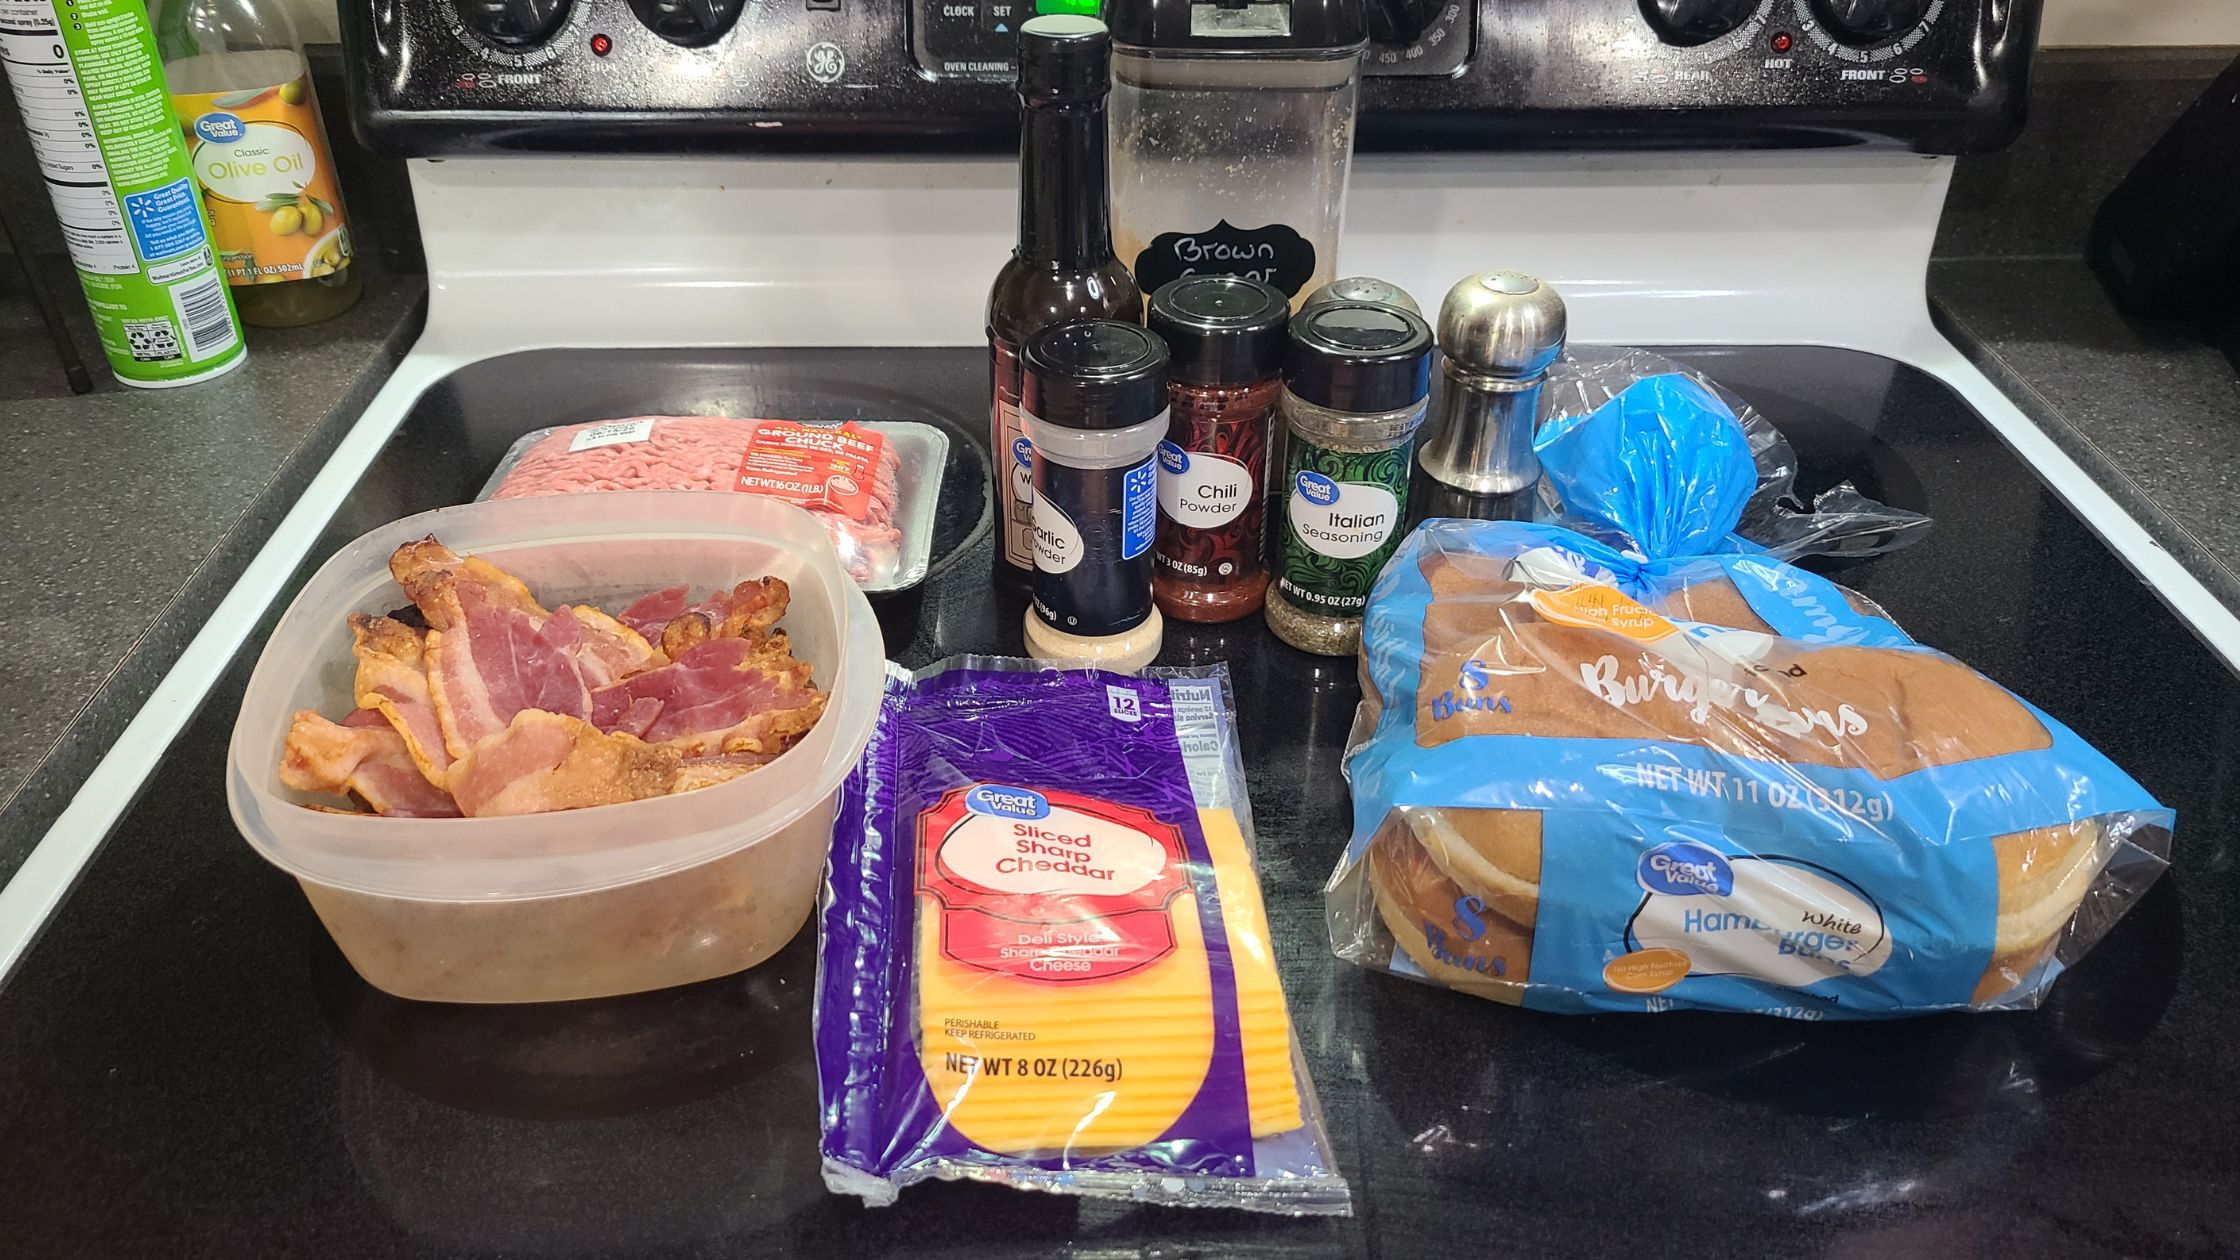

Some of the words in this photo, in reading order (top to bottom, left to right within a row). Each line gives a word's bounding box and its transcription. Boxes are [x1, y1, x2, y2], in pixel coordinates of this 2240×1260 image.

[943, 6, 975, 17] CLOCK
[993, 6, 1012, 17] SET
[1445, 4, 1460, 24] 300
[1802, 20, 1815, 31] 3
[1919, 21, 1929, 32] 7
[1428, 28, 1446, 46] 350
[52, 44, 65, 59] 0
[1405, 45, 1424, 59] 400
[1828, 43, 1838, 55] 4
[1893, 43, 1903, 55] 6
[513, 56, 524, 67] 5
[1380, 52, 1398, 63] 450
[1764, 58, 1793, 69] HOT
[1860, 51, 1869, 63] 5
[944, 62, 967, 72] OVEN
[968, 62, 1009, 72] CLEANING
[498, 73, 542, 85] FRONT
[1840, 70, 1886, 80] FRONT
[200, 119, 237, 132] Great
[210, 126, 239, 138] Value
[233, 147, 270, 158] Classic
[208, 161, 267, 180] Olive
[273, 153, 304, 173] Oil
[1173, 237, 1274, 262] Brown
[757, 428, 834, 441] GROUND
[837, 435, 875, 452] BEEF
[785, 436, 844, 451] CHUCK
[1158, 443, 1183, 464] Great
[1162, 457, 1183, 470] Value
[741, 476, 760, 487] NET
[1300, 475, 1332, 495] Great
[1198, 484, 1237, 499] Chili
[1305, 488, 1332, 501] Value
[1180, 498, 1238, 514] Powder
[1329, 512, 1385, 529] Italian
[1302, 523, 1383, 543] Seasoning
[1033, 538, 1066, 565] owder
[1172, 561, 1183, 571] OZ
[1184, 563, 1208, 577] (85g)
[1293, 584, 1306, 599] WT
[1306, 591, 1326, 605] 0.95
[1327, 597, 1341, 607] OZ
[1341, 594, 1366, 608] (27g)
[1112, 696, 1136, 711] 12
[1432, 691, 1512, 721] Buns
[1114, 708, 1138, 717] SLICES
[1634, 761, 1682, 790] NET
[1686, 768, 1727, 800] WT
[1732, 777, 1760, 804] 11
[1767, 780, 1801, 810] OZ
[1805, 785, 1895, 822] (312g)
[977, 790, 1036, 809] Great
[991, 802, 1036, 816] Value
[1013, 824, 1092, 848] Sliced
[1016, 840, 1091, 864] Sharp
[995, 857, 1115, 882] Cheddar
[1650, 853, 1718, 883] Great
[1665, 869, 1719, 893] Value
[1801, 910, 1862, 935] White
[1018, 933, 1053, 945] Deli
[1057, 932, 1099, 945] Style
[1029, 960, 1092, 972] Cheese
[1613, 965, 1627, 974] No
[1628, 962, 1650, 973] High
[1626, 972, 1649, 980] Corn
[944, 1018, 1000, 1030] PERISHABLE
[944, 1029, 967, 1038] KEEP
[968, 1030, 1036, 1041] REFRIGERATED
[946, 1052, 979, 1075] NET
[983, 1057, 1012, 1076] WT
[1017, 1058, 1028, 1077] 8
[1033, 1058, 1058, 1077] OZ
[1062, 1058, 1123, 1083] (226g)
